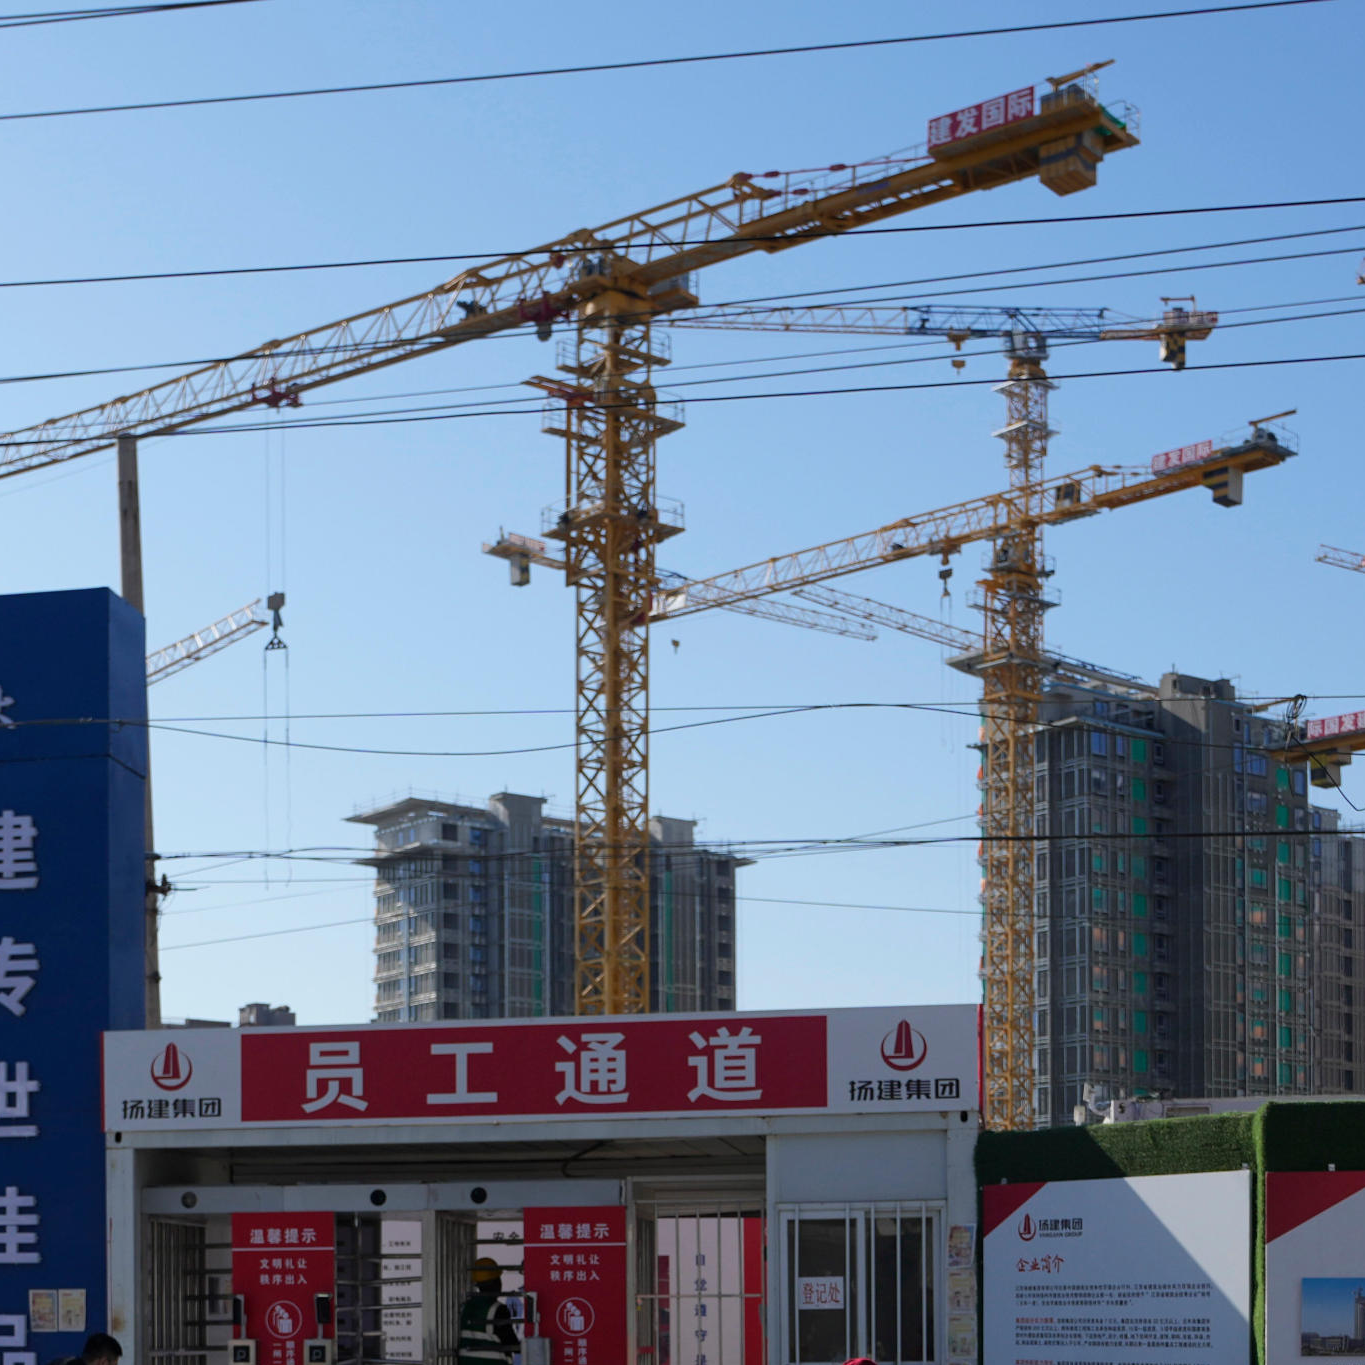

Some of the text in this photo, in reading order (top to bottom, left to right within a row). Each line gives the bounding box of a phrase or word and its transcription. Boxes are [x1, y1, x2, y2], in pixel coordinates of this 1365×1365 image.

[931, 88, 1033, 146] 建发国际
[301, 1026, 764, 1114] 员工通道
[848, 1077, 961, 1102] 扬建集团
[121, 1096, 222, 1120] 扬建集团
[250, 1228, 317, 1245] 温馨提示
[540, 1224, 610, 1240] 温馨提示
[260, 1257, 308, 1270] 文明礼让
[550, 1254, 600, 1266] 文明礼让
[260, 1273, 308, 1286] 秩序出入
[550, 1270, 600, 1282] 秩序出入
[802, 1281, 841, 1304] 登记处
